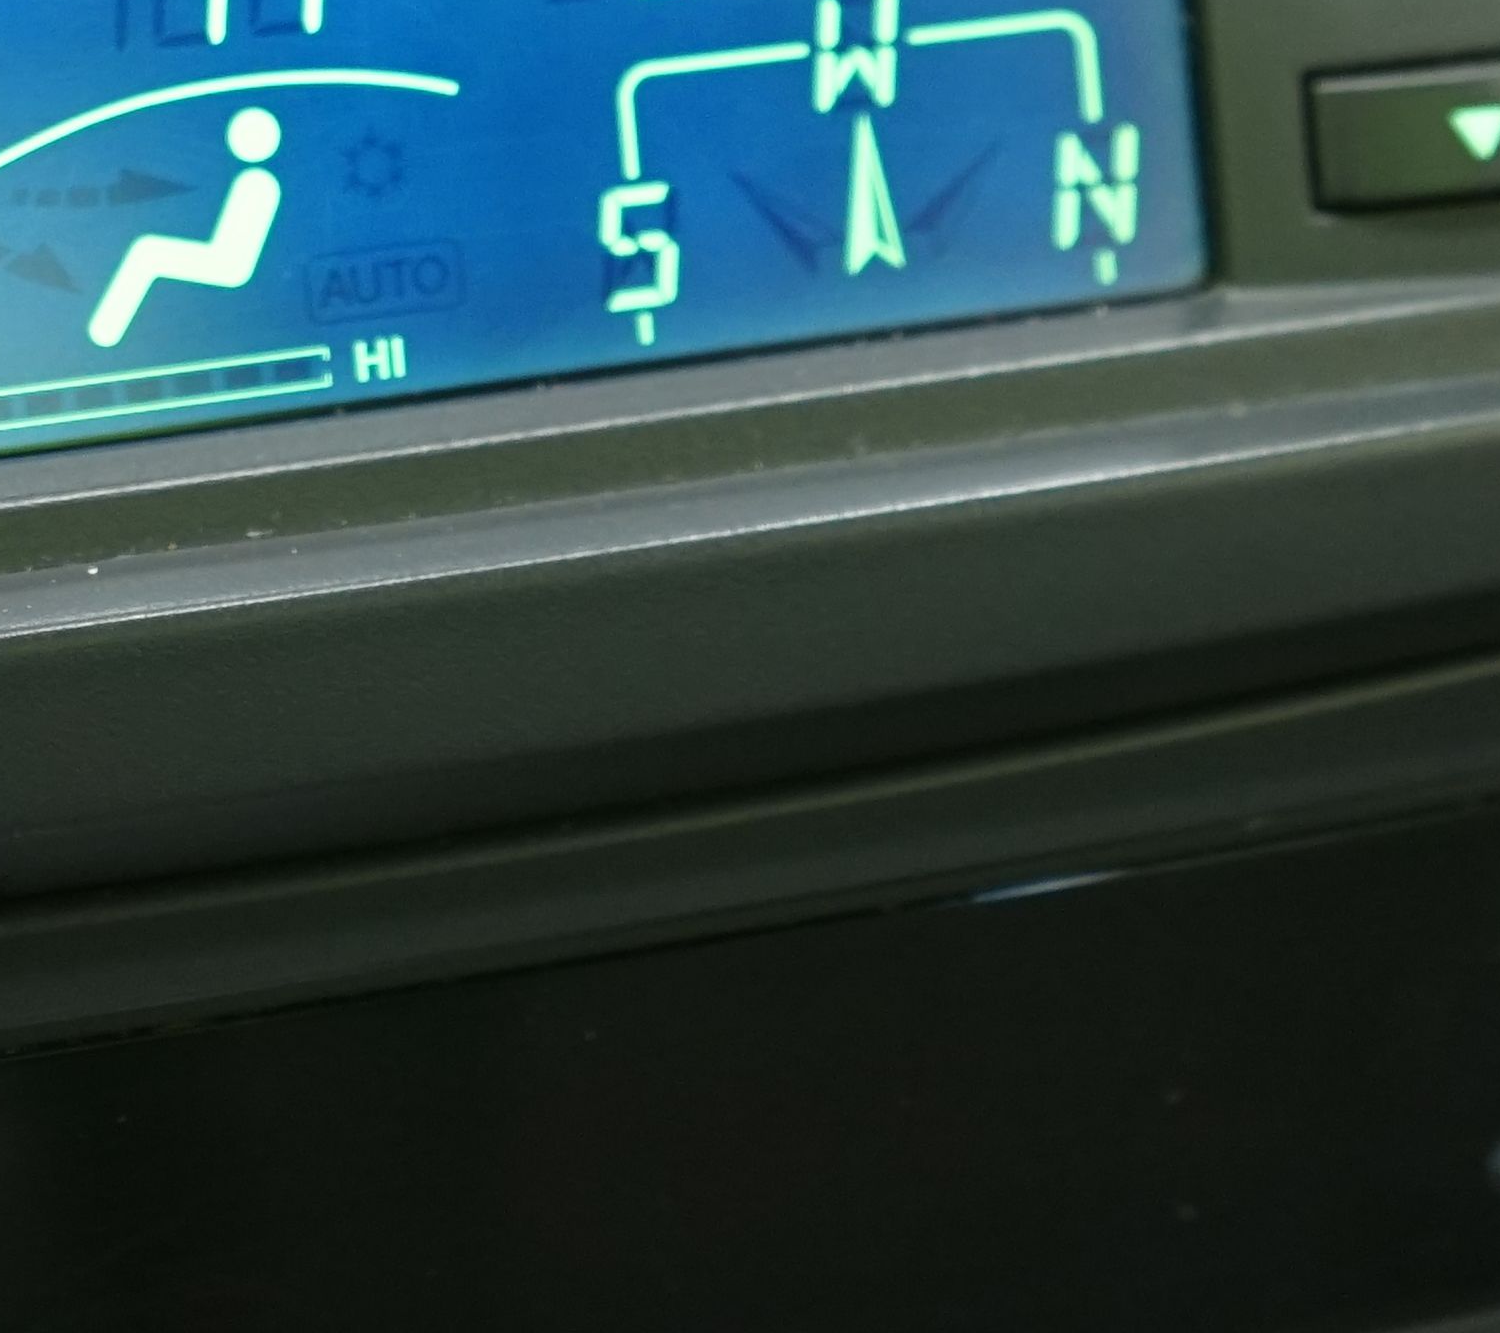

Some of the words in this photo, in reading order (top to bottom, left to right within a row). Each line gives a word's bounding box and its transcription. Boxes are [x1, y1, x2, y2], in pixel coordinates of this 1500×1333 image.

[1052, 122, 1140, 251] N
[317, 252, 452, 310] AUTO
[598, 180, 680, 314] S
[352, 335, 407, 384] HI
